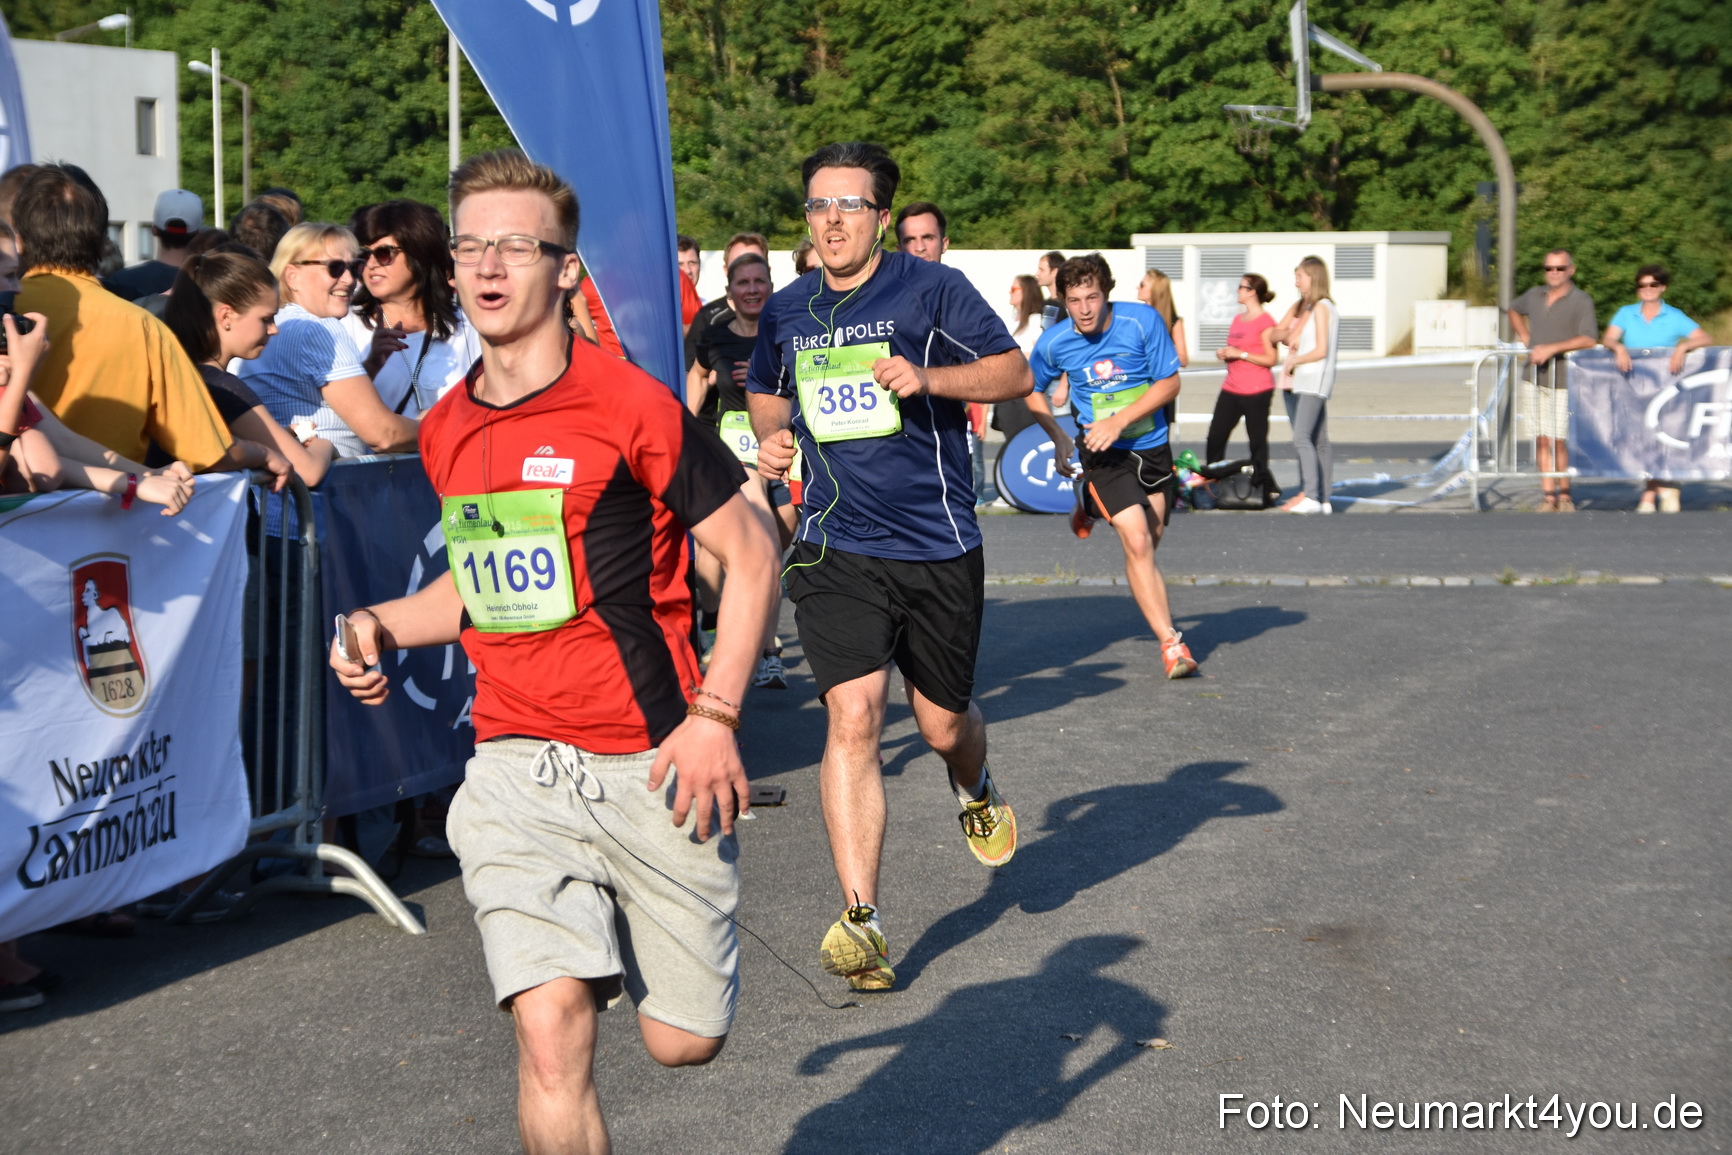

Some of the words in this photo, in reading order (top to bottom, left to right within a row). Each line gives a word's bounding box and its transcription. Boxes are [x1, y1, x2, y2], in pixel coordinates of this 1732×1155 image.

[846, 320, 895, 341] POLES
[818, 382, 877, 415] 385
[459, 517, 494, 528] firmenlau
[463, 547, 556, 594] 1169
[486, 604, 511, 612] Heinrich
[512, 602, 538, 611] Obholz
[101, 677, 136, 703] 1628
